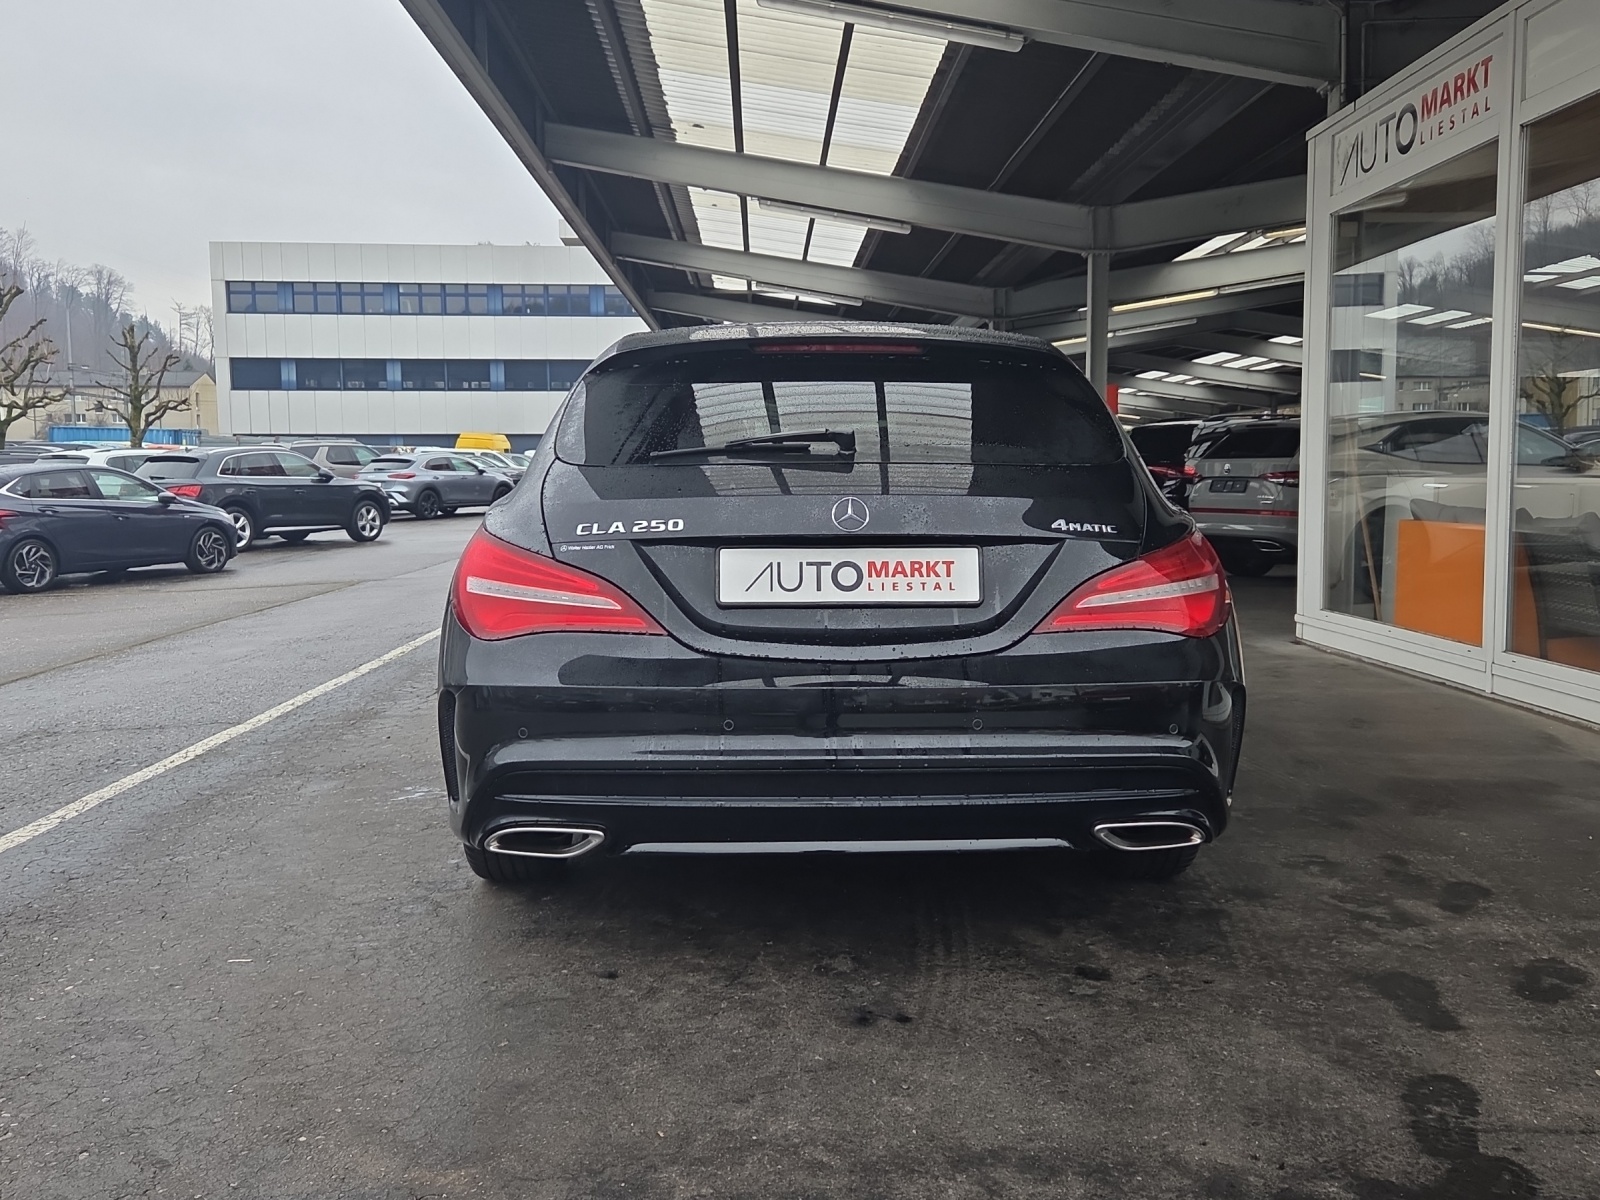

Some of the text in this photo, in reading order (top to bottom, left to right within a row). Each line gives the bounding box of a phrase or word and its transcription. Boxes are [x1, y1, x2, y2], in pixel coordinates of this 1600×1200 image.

[1340, 54, 1493, 186] AUTO MARKT
[1420, 96, 1491, 145] LIESTAL
[576, 518, 684, 536] CLA 250
[1051, 518, 1118, 534] 4MATIC
[744, 560, 955, 593] AUTO MARKT
[867, 582, 956, 592] LIESTAL
